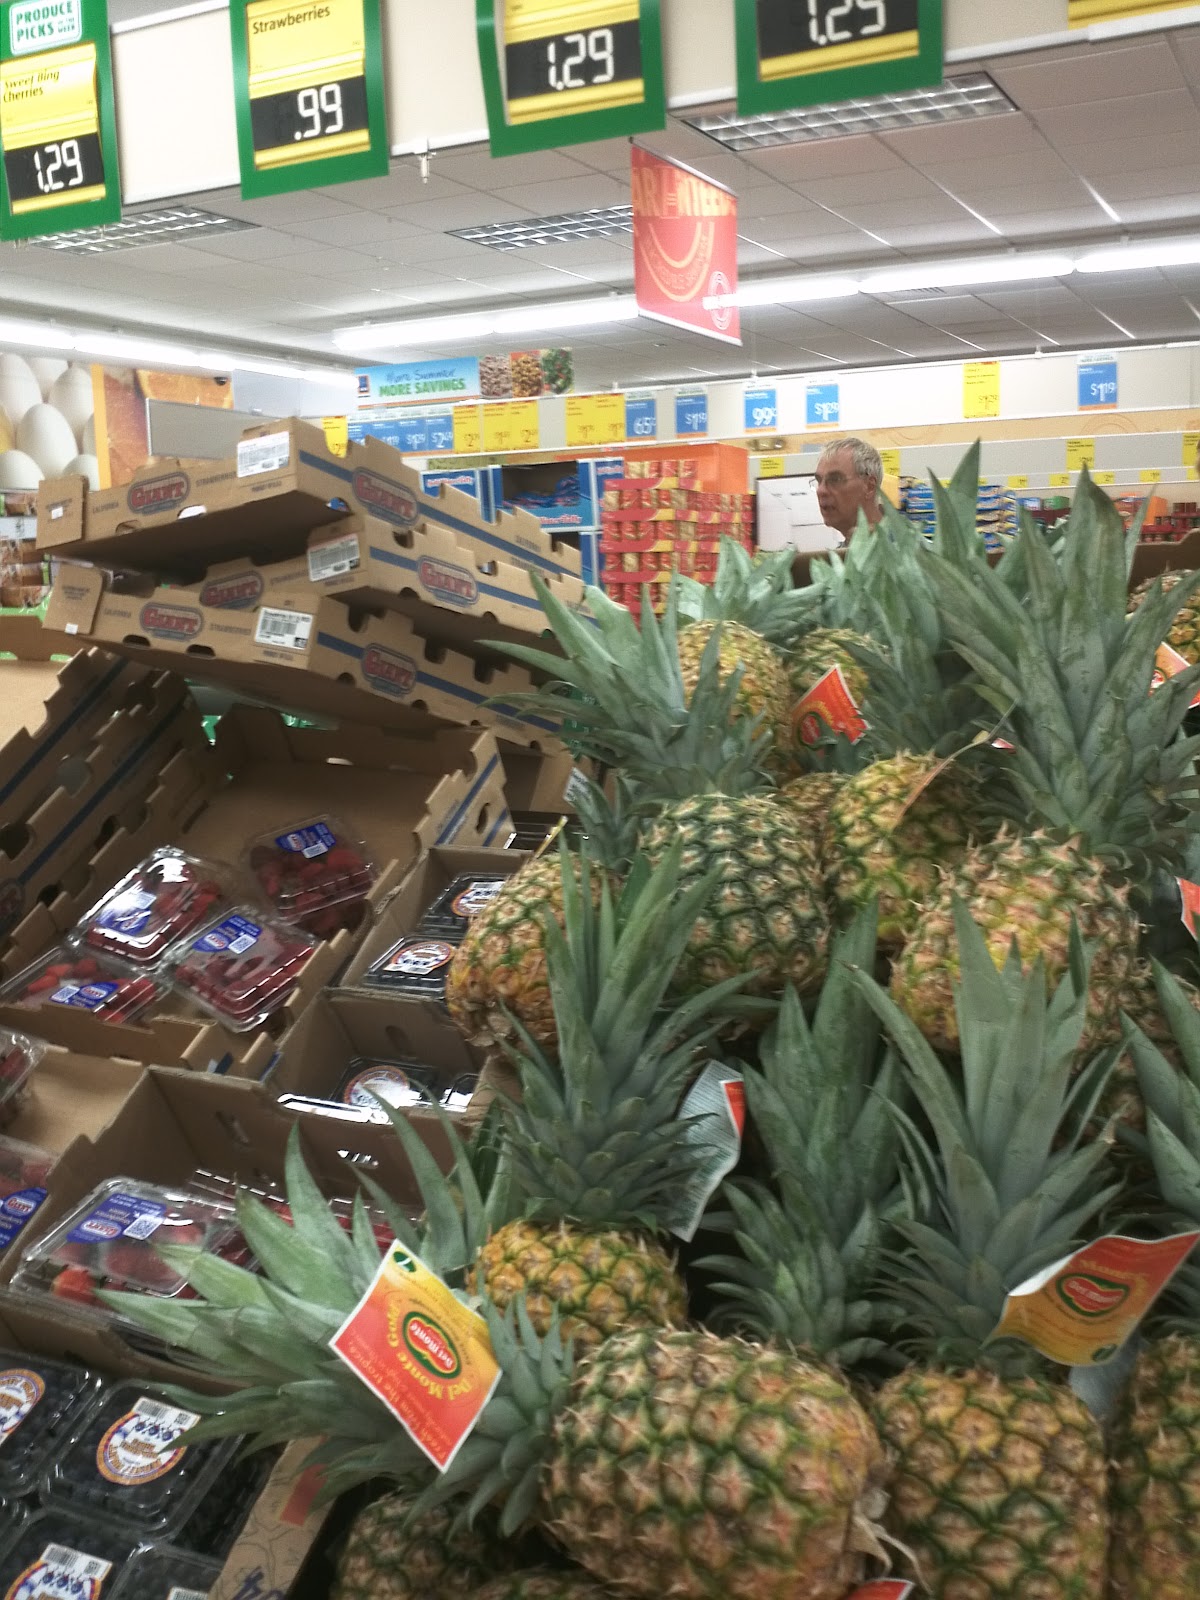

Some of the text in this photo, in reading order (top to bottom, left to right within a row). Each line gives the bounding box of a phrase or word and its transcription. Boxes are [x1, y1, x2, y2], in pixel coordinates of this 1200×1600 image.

[16, 1, 73, 25] PRODUCE
[252, 5, 331, 35] Strawberries
[16, 22, 54, 43] PICKS
[547, 28, 615, 91] 1.29
[3, 87, 44, 103] Cherries
[294, 83, 344, 141] .99
[33, 139, 84, 193] 1.29
[379, 377, 467, 397] MORE SAVINGS
[397, 1352, 442, 1399] Monte
[381, 1382, 401, 1404] the
[449, 1380, 470, 1400] Del
